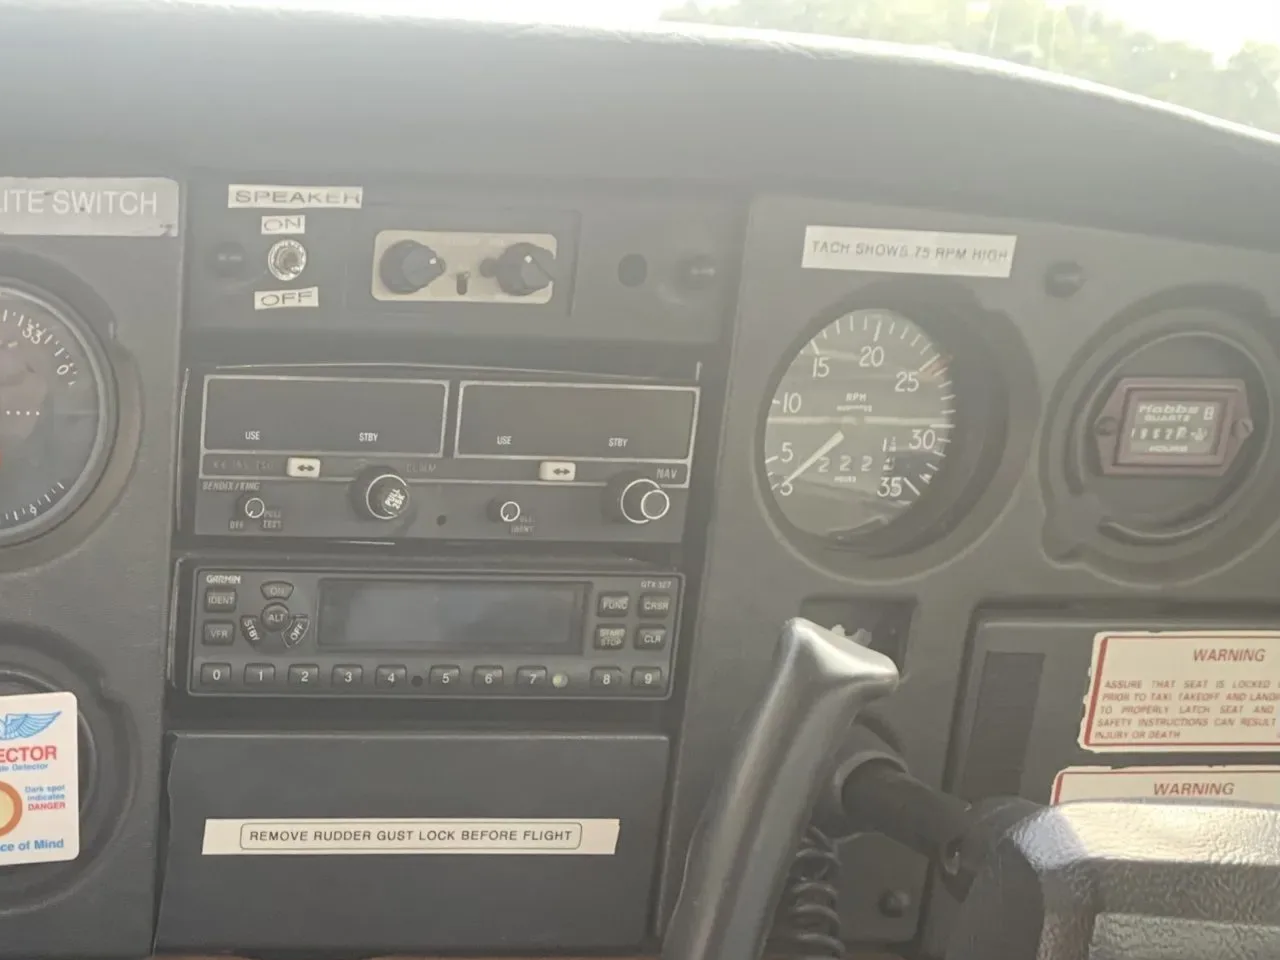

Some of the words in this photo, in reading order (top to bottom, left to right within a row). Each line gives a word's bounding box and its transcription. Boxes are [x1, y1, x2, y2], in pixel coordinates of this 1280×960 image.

[52, 191, 157, 214] SWITCH
[264, 217, 301, 231] ON
[812, 240, 850, 254] TACH
[260, 291, 313, 307] OFF
[859, 345, 884, 367] 20
[812, 357, 830, 378] 15
[895, 371, 920, 392] 25
[782, 392, 802, 413] 10
[245, 430, 260, 441] USE
[359, 432, 378, 442] STBY
[496, 436, 512, 445] USE
[608, 438, 628, 447] STBY
[908, 428, 936, 450] 30
[781, 442, 794, 463] 5
[876, 476, 903, 498] 35
[208, 595, 234, 605] IDENT
[268, 613, 285, 622] ALT
[289, 622, 305, 641] OFF
[1192, 648, 1266, 664] WARNING
[12, 763, 49, 772] Detector
[25, 785, 44, 794] Dark
[46, 784, 66, 795] spot
[1153, 782, 1235, 796] WARNING
[27, 793, 66, 802] indicates
[27, 801, 66, 812] DANGER
[249, 830, 309, 842] REMOVE
[313, 830, 372, 842] RUDDER
[376, 830, 415, 842] GUST
[418, 830, 456, 842] LOCK
[461, 830, 518, 842] BEFORE
[522, 830, 573, 843] FLIGHT
[18, 840, 31, 850] of
[33, 838, 65, 850] Mind
